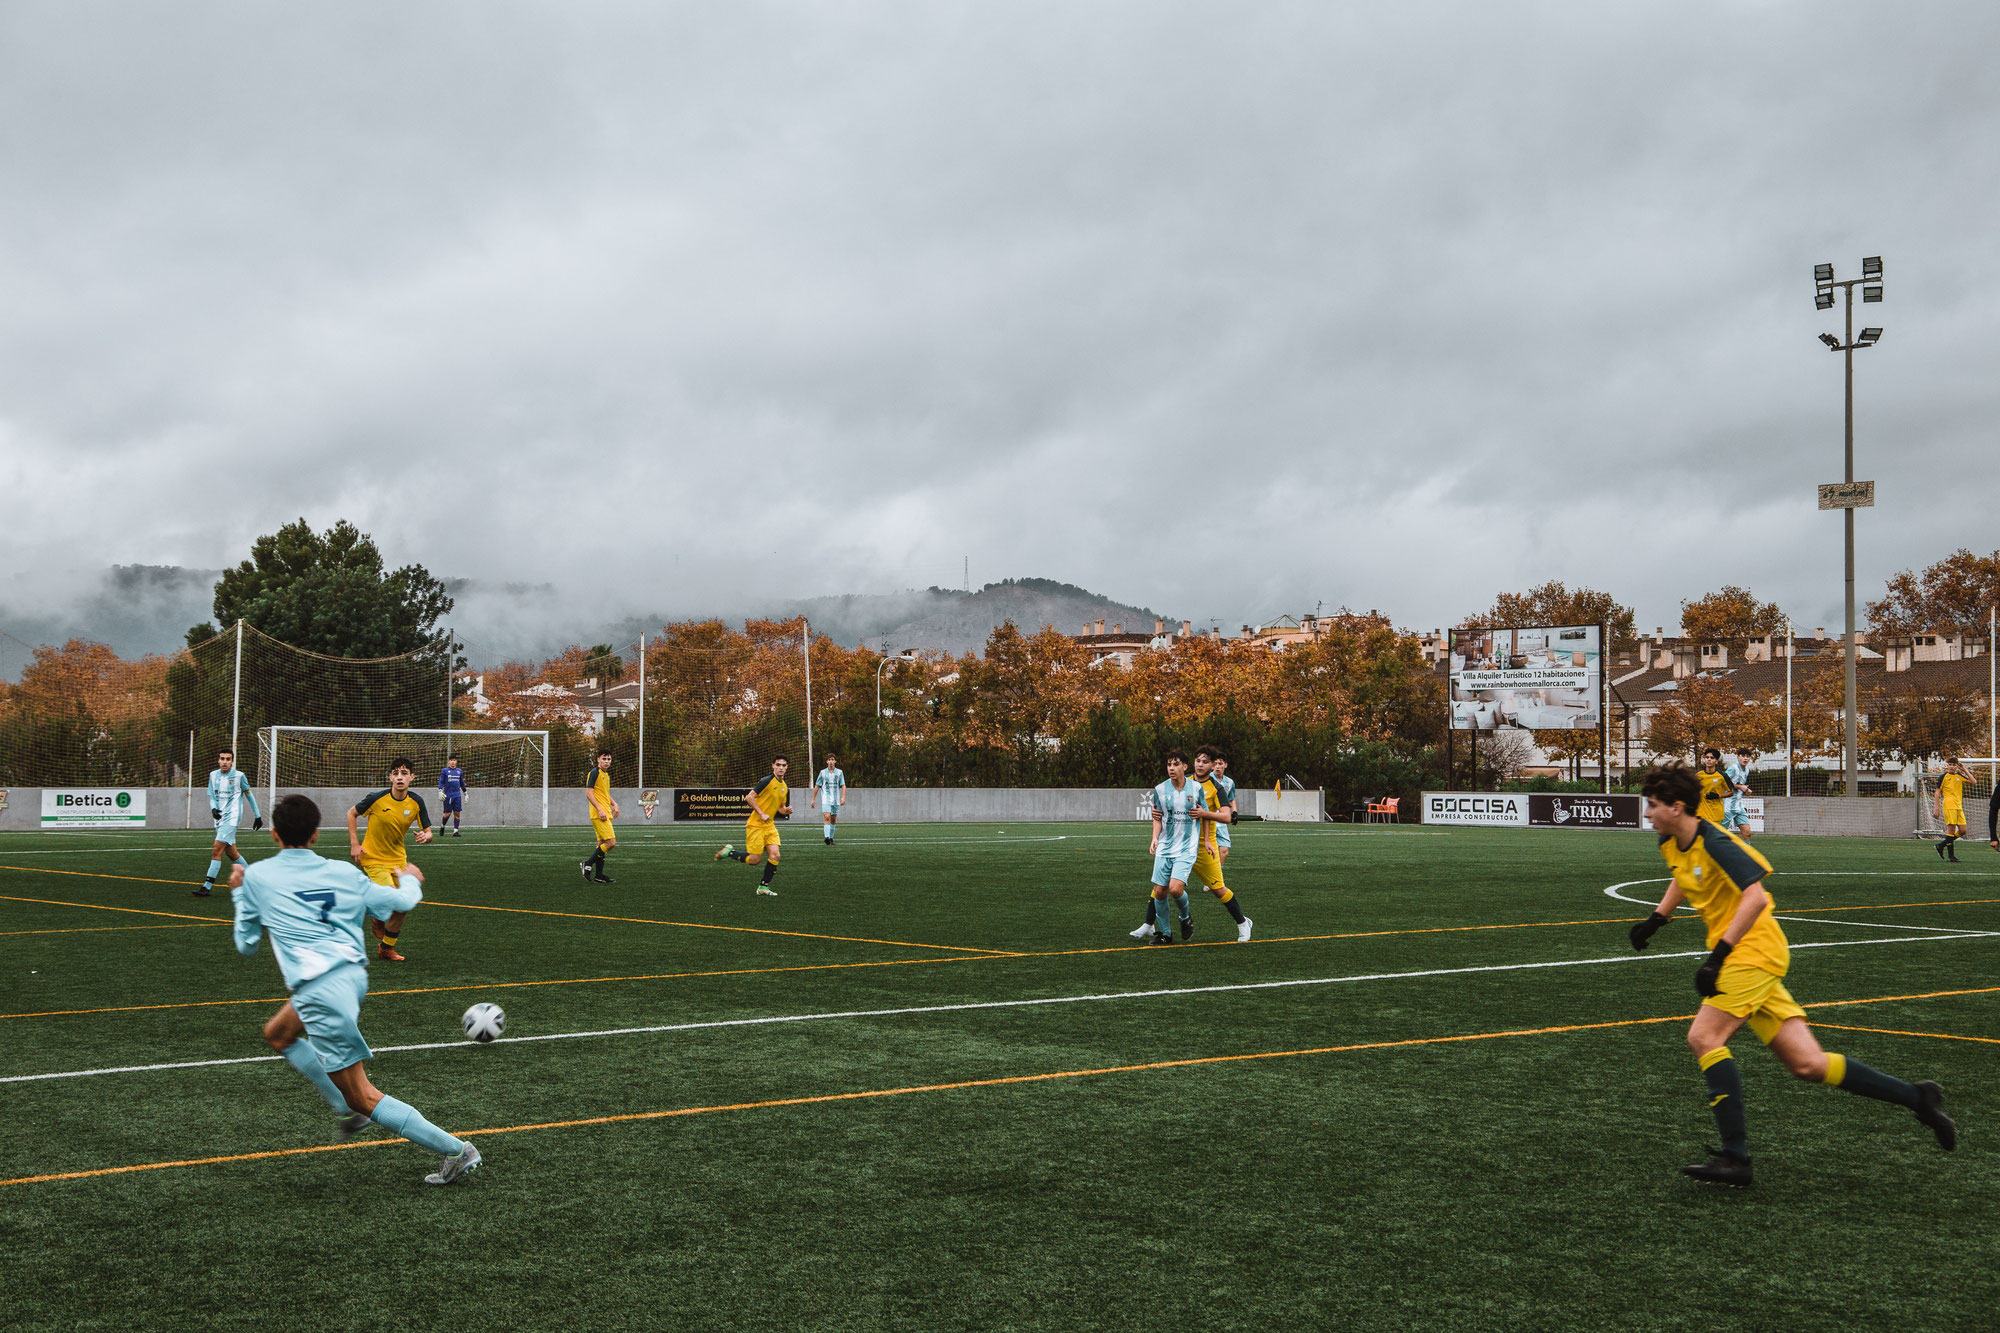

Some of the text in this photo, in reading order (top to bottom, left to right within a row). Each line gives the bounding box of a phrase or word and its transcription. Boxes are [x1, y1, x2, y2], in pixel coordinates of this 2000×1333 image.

[1463, 672, 1476, 680] Villa
[1477, 672, 1502, 681] Alquiler
[1502, 671, 1532, 679] Turisitico
[1543, 670, 1585, 678] habitaciones
[1471, 680, 1576, 688] www.rainbowhomemallorca.com
[690, 794, 717, 802] Golden
[718, 794, 740, 802] House
[1431, 798, 1518, 813] GOCCISA
[1570, 805, 1613, 819] TRIAS
[1136, 807, 1153, 820] IM
[294, 889, 336, 923] 7
